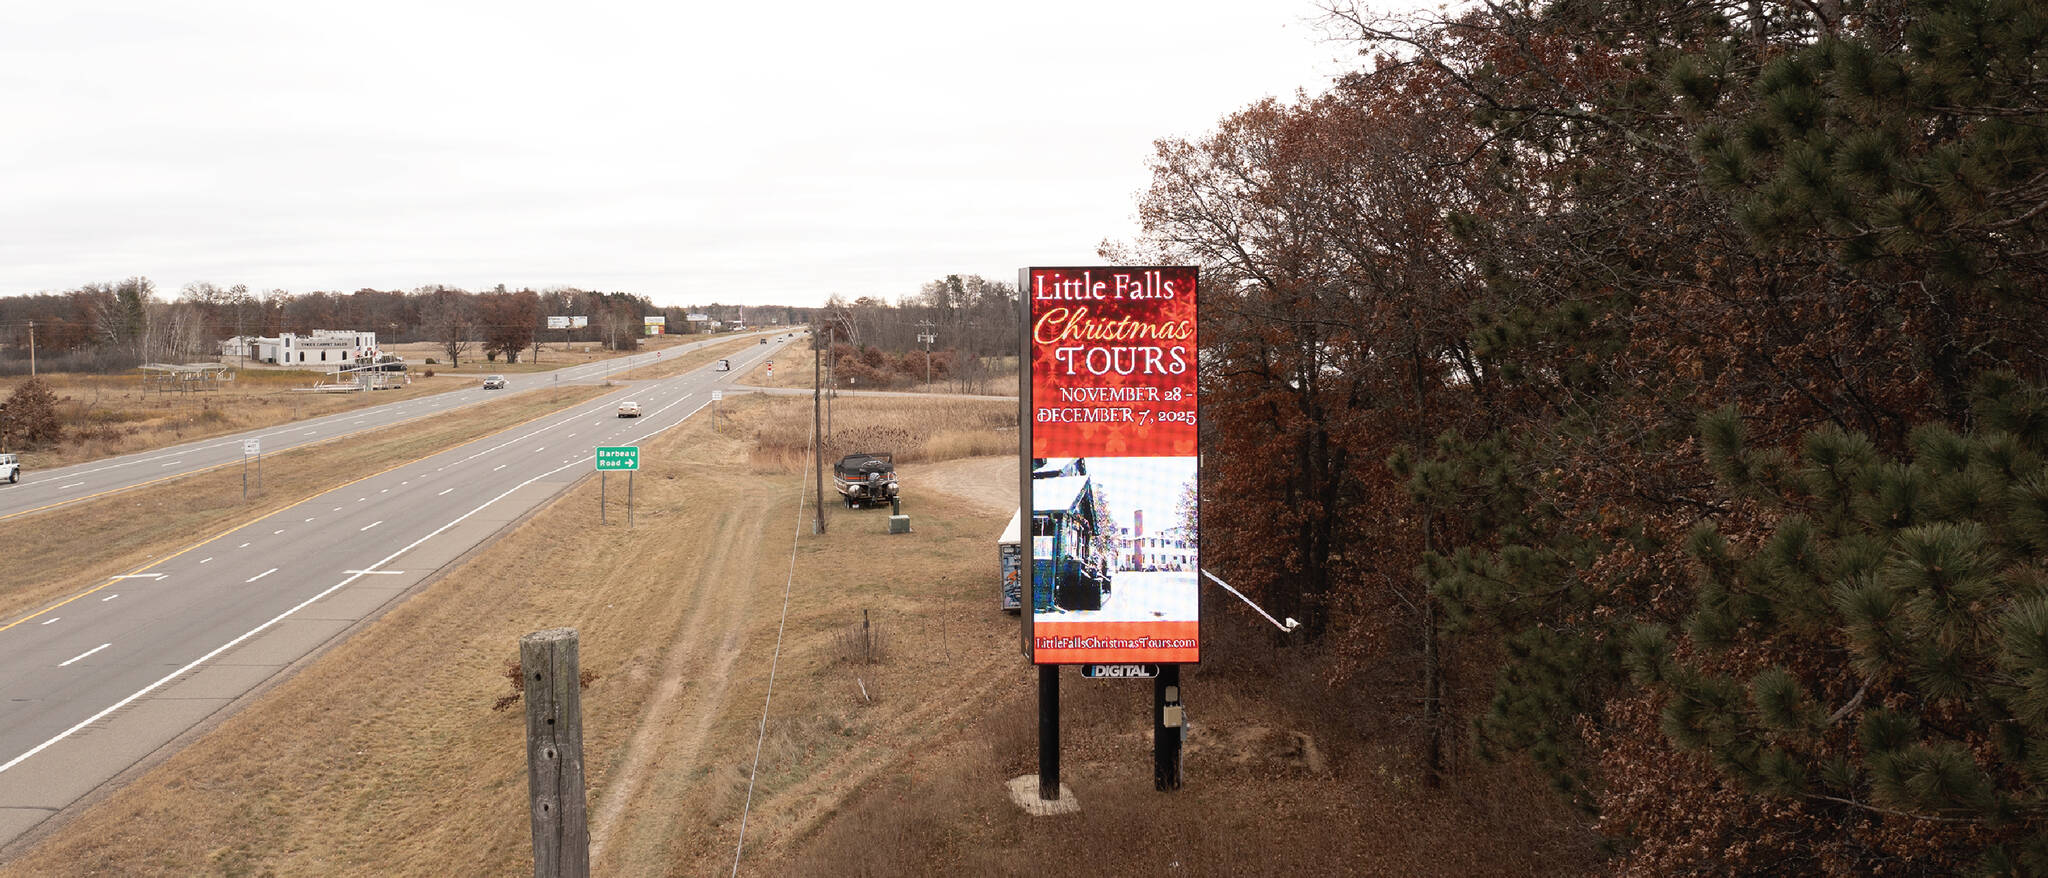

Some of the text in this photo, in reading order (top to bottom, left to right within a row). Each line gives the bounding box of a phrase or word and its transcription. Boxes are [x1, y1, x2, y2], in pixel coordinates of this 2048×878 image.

[1036, 271, 1174, 300] Little Falls
[1034, 307, 1193, 344] Christmas
[1055, 344, 1186, 375] TOURS
[1060, 387, 1160, 402] NOVEMBER
[1164, 387, 1182, 401] 28
[1037, 408, 1196, 426] DECEMBER 7, 2025
[599, 459, 621, 467] Road
[1036, 634, 1196, 649] LittleFallsChristmasTours.com
[1091, 665, 1150, 677] iDIGITAL
